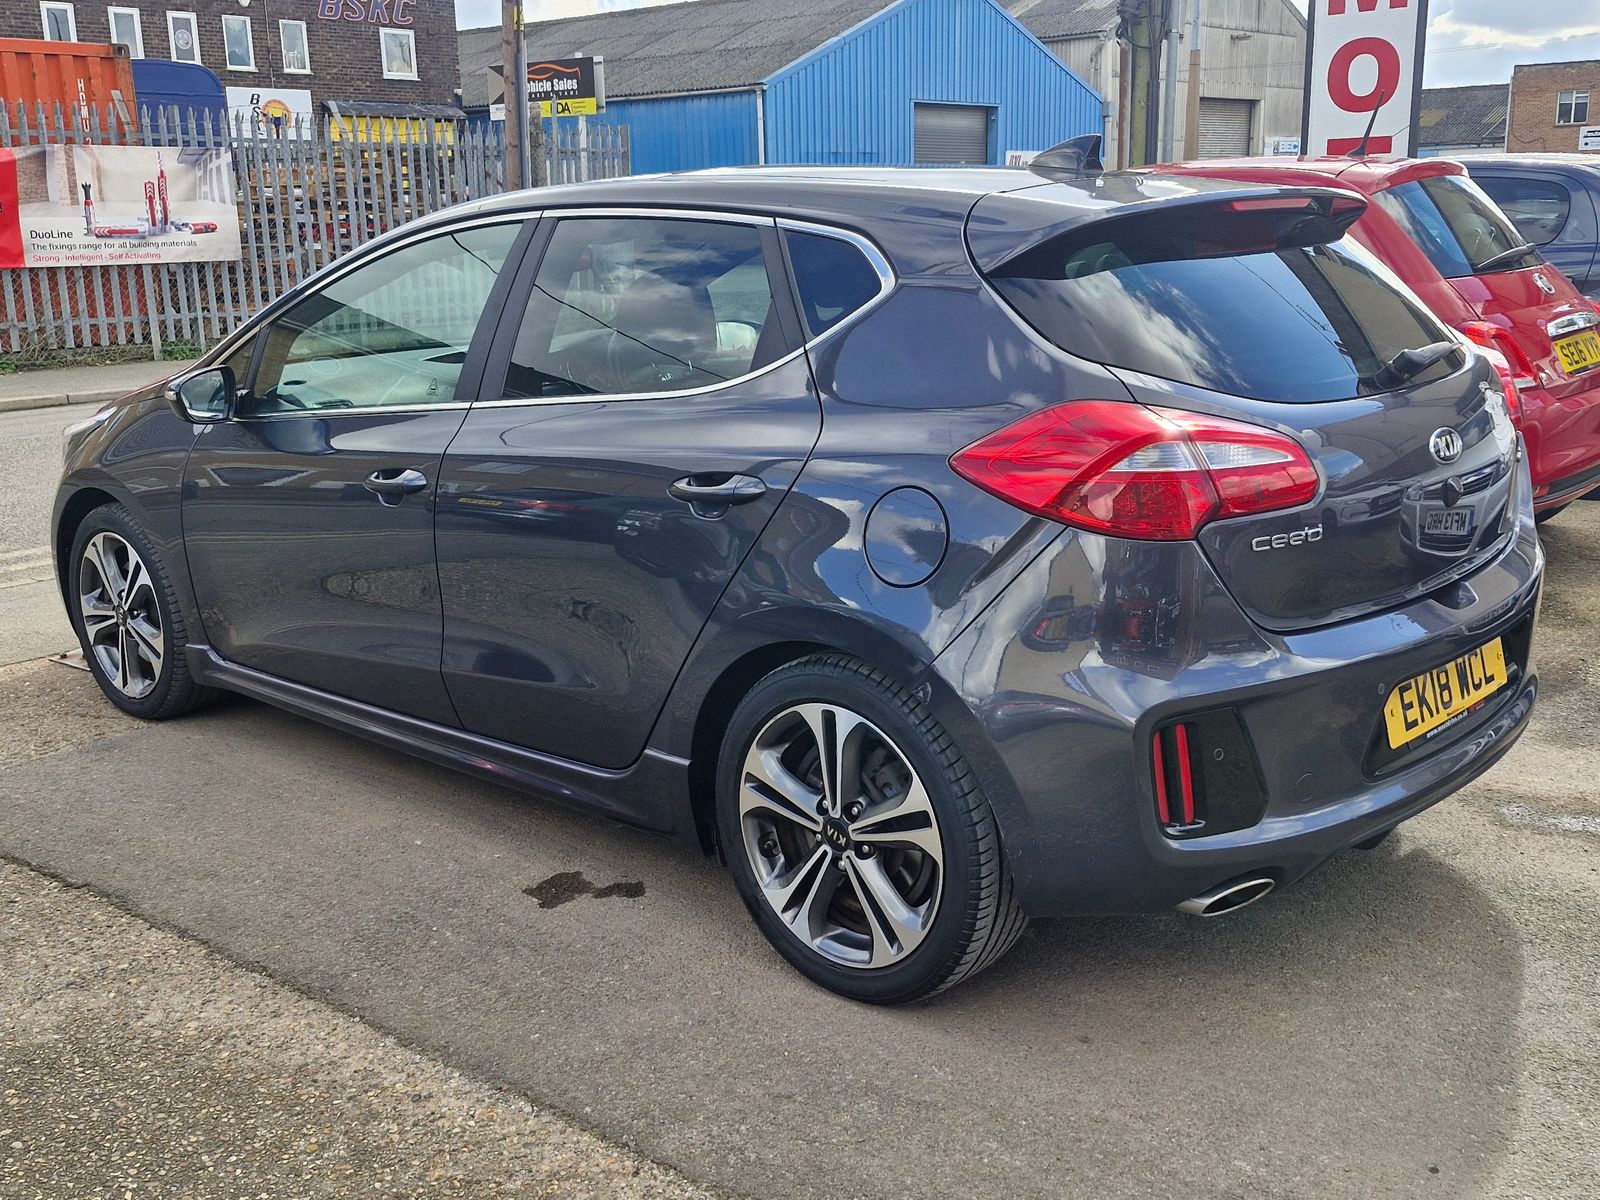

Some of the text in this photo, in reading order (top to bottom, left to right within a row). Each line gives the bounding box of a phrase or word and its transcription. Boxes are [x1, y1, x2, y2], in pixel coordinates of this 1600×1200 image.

[318, 0, 416, 24] BSKC
[527, 78, 578, 93] ehicle Sales
[29, 229, 74, 240] DuoLine
[31, 239, 198, 251] The fixings range for all building materials
[32, 254, 60, 264] Strong
[64, 253, 103, 262] Intelligent
[108, 252, 124, 261] Self
[124, 251, 161, 261] Activating
[1559, 341, 1587, 367] SE16
[1434, 433, 1463, 458] KIA
[1398, 665, 1453, 732] EK18
[1454, 647, 1495, 701] WCL
[827, 824, 847, 847] KIA
